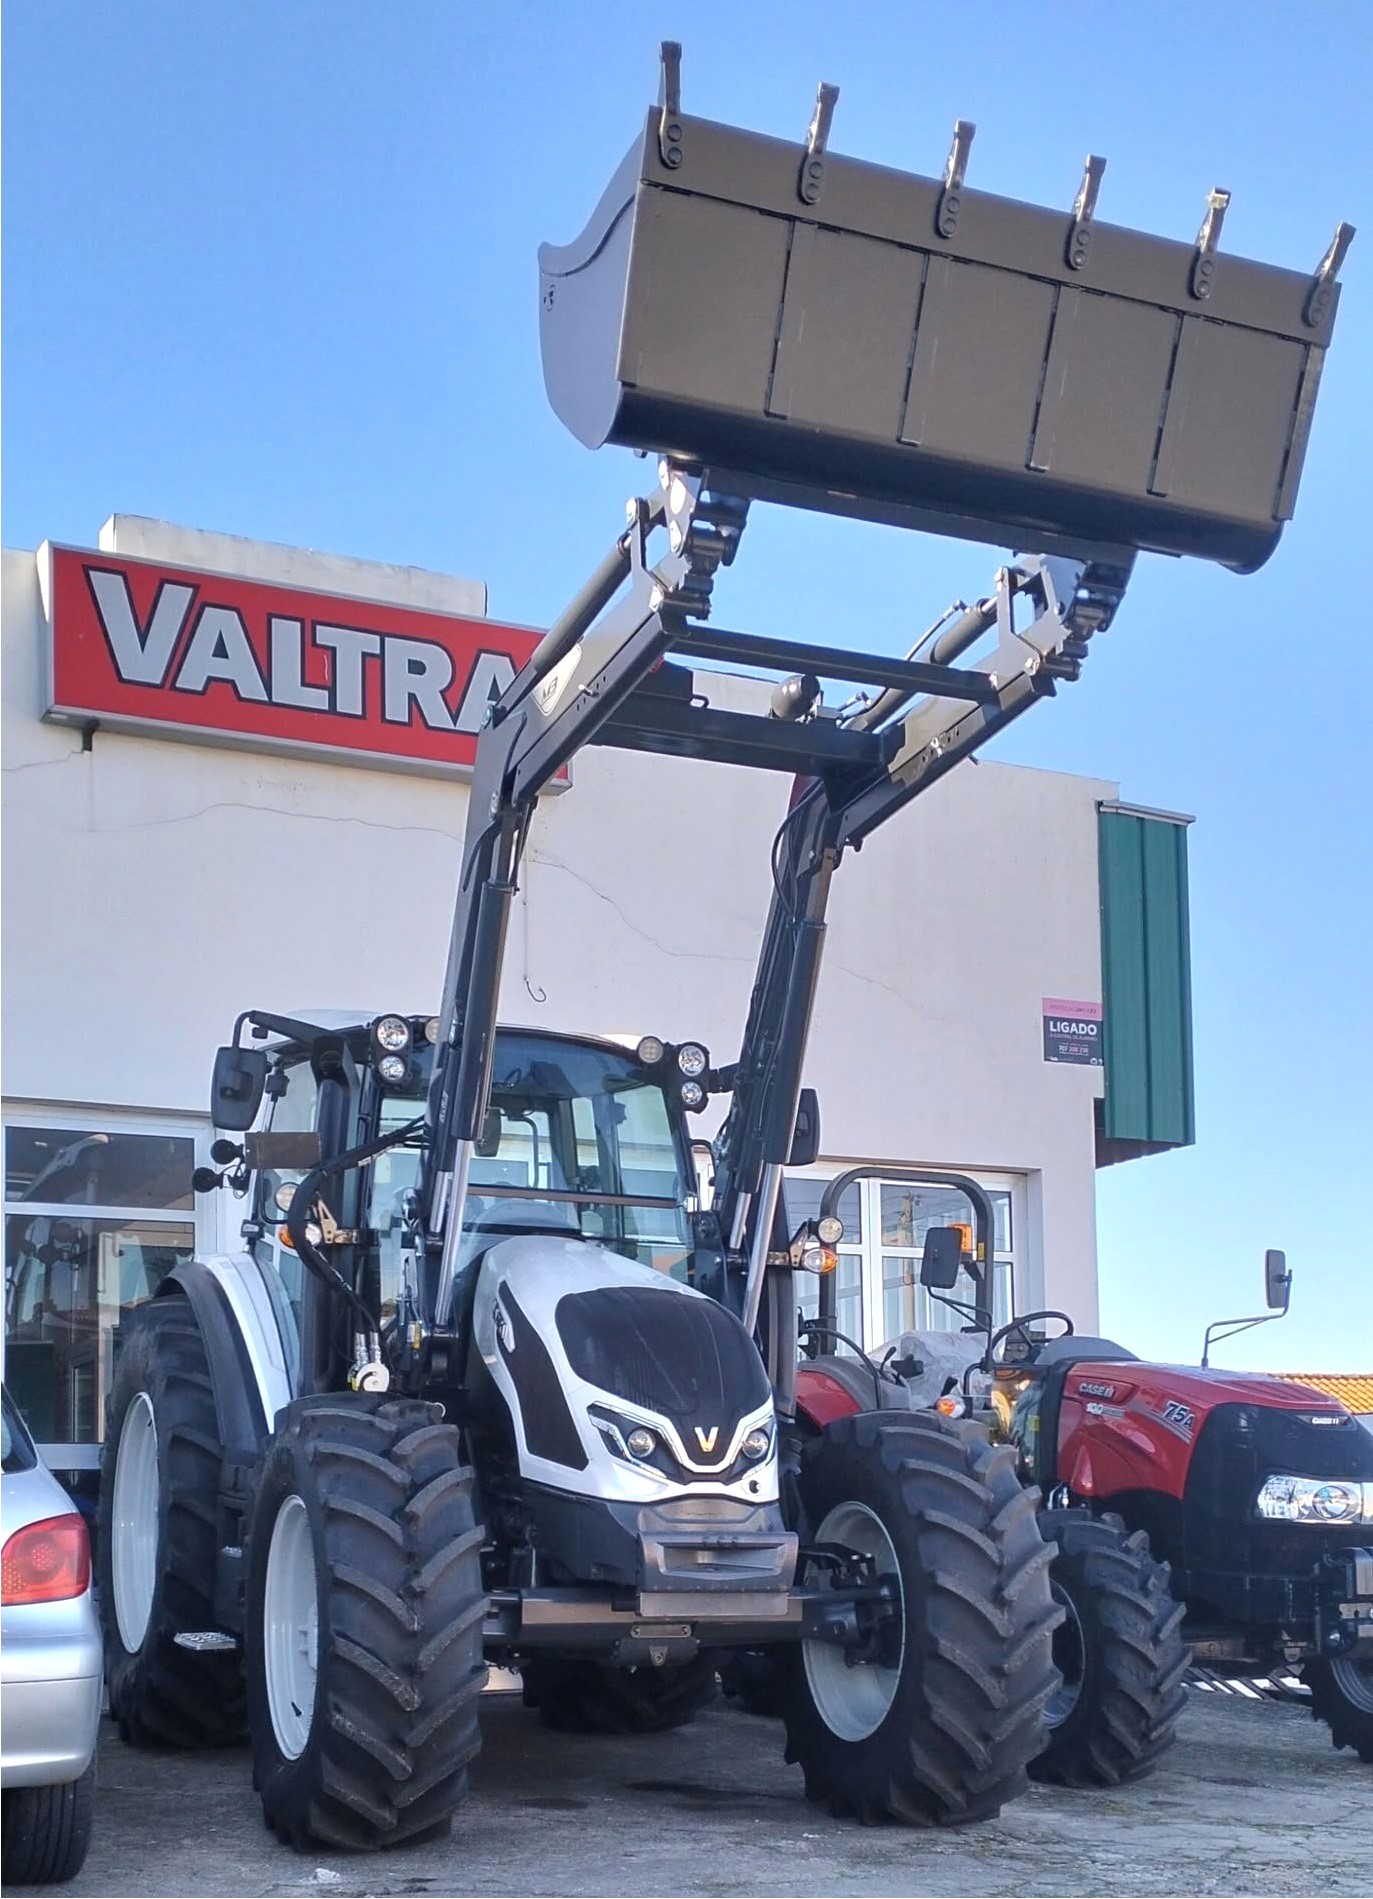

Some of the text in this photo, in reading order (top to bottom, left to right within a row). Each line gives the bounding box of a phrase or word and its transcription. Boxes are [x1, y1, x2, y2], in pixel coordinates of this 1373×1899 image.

[82, 565, 524, 735] VALTRA
[1049, 1021, 1097, 1035] LIGADO
[1162, 1400, 1196, 1428] 75A
